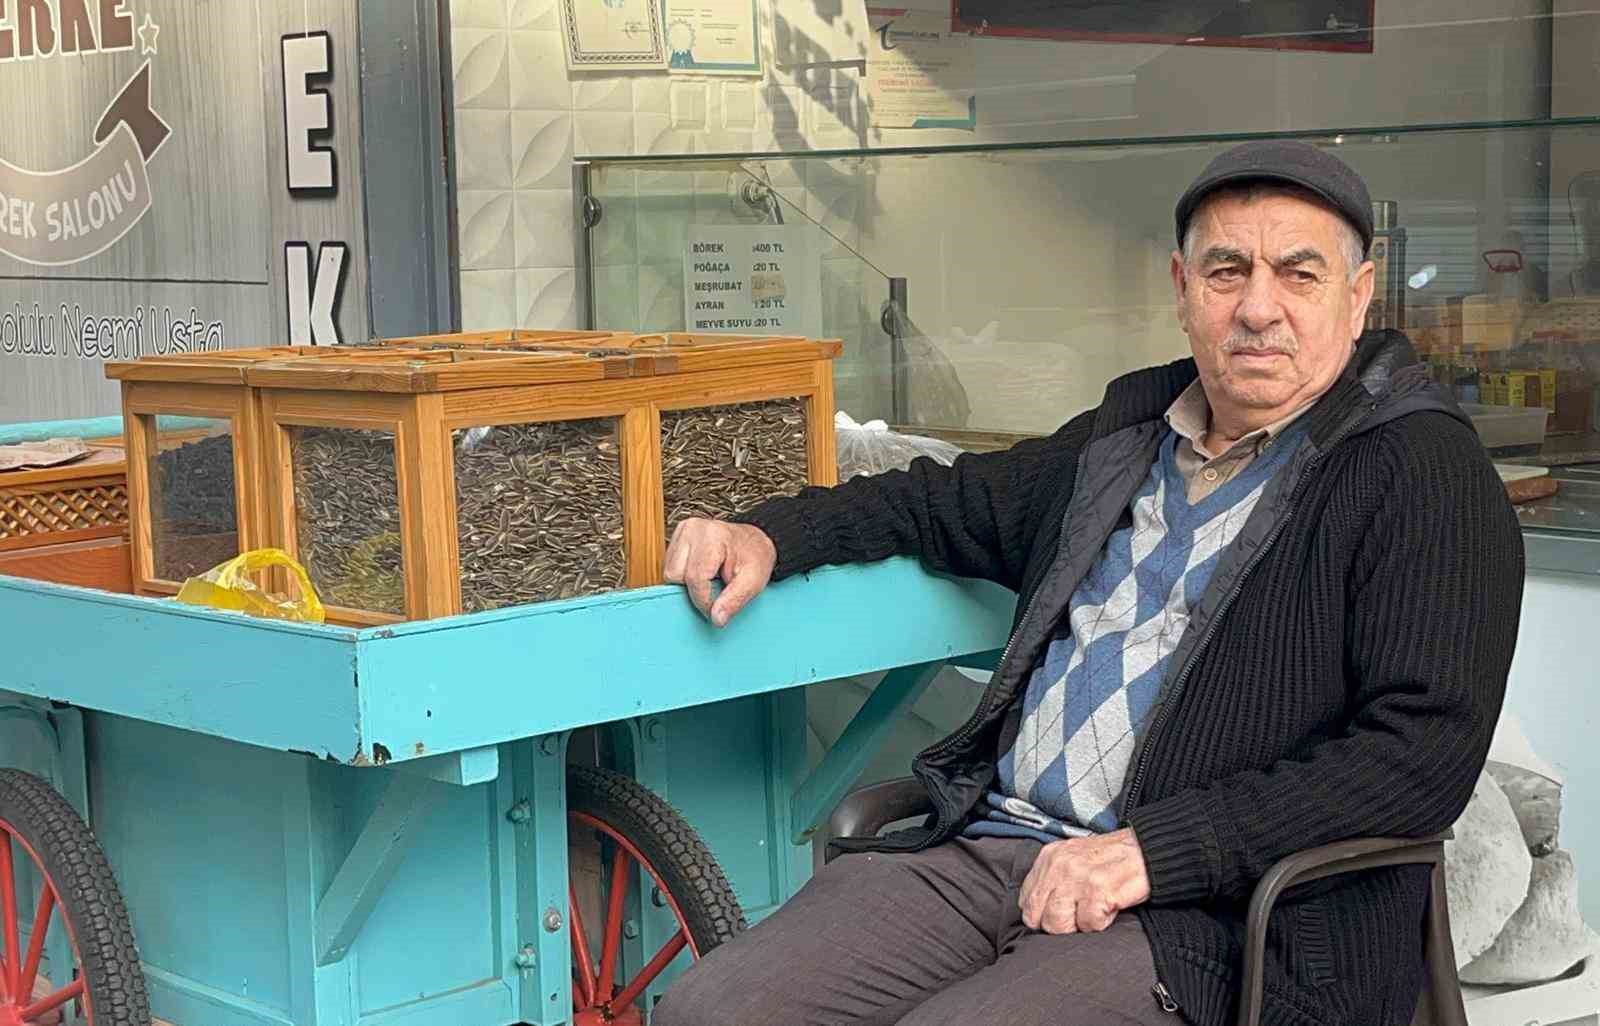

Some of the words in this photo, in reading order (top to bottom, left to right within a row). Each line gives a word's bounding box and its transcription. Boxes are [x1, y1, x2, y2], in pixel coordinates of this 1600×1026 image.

[45, 159, 137, 241] SALONU
[693, 242, 724, 253] BÖREK
[772, 243, 785, 253] TL
[694, 262, 730, 274] POĞAÇA
[768, 263, 780, 271] TL
[694, 281, 742, 292] MEŞRUBAT
[695, 301, 724, 310] AYRAN
[696, 319, 725, 329] MEYVE
[726, 319, 752, 328] SUYU
[770, 318, 782, 327] TL
[0, 303, 56, 356] olulu
[60, 303, 144, 360] Necmi
[150, 306, 225, 355] Usta
